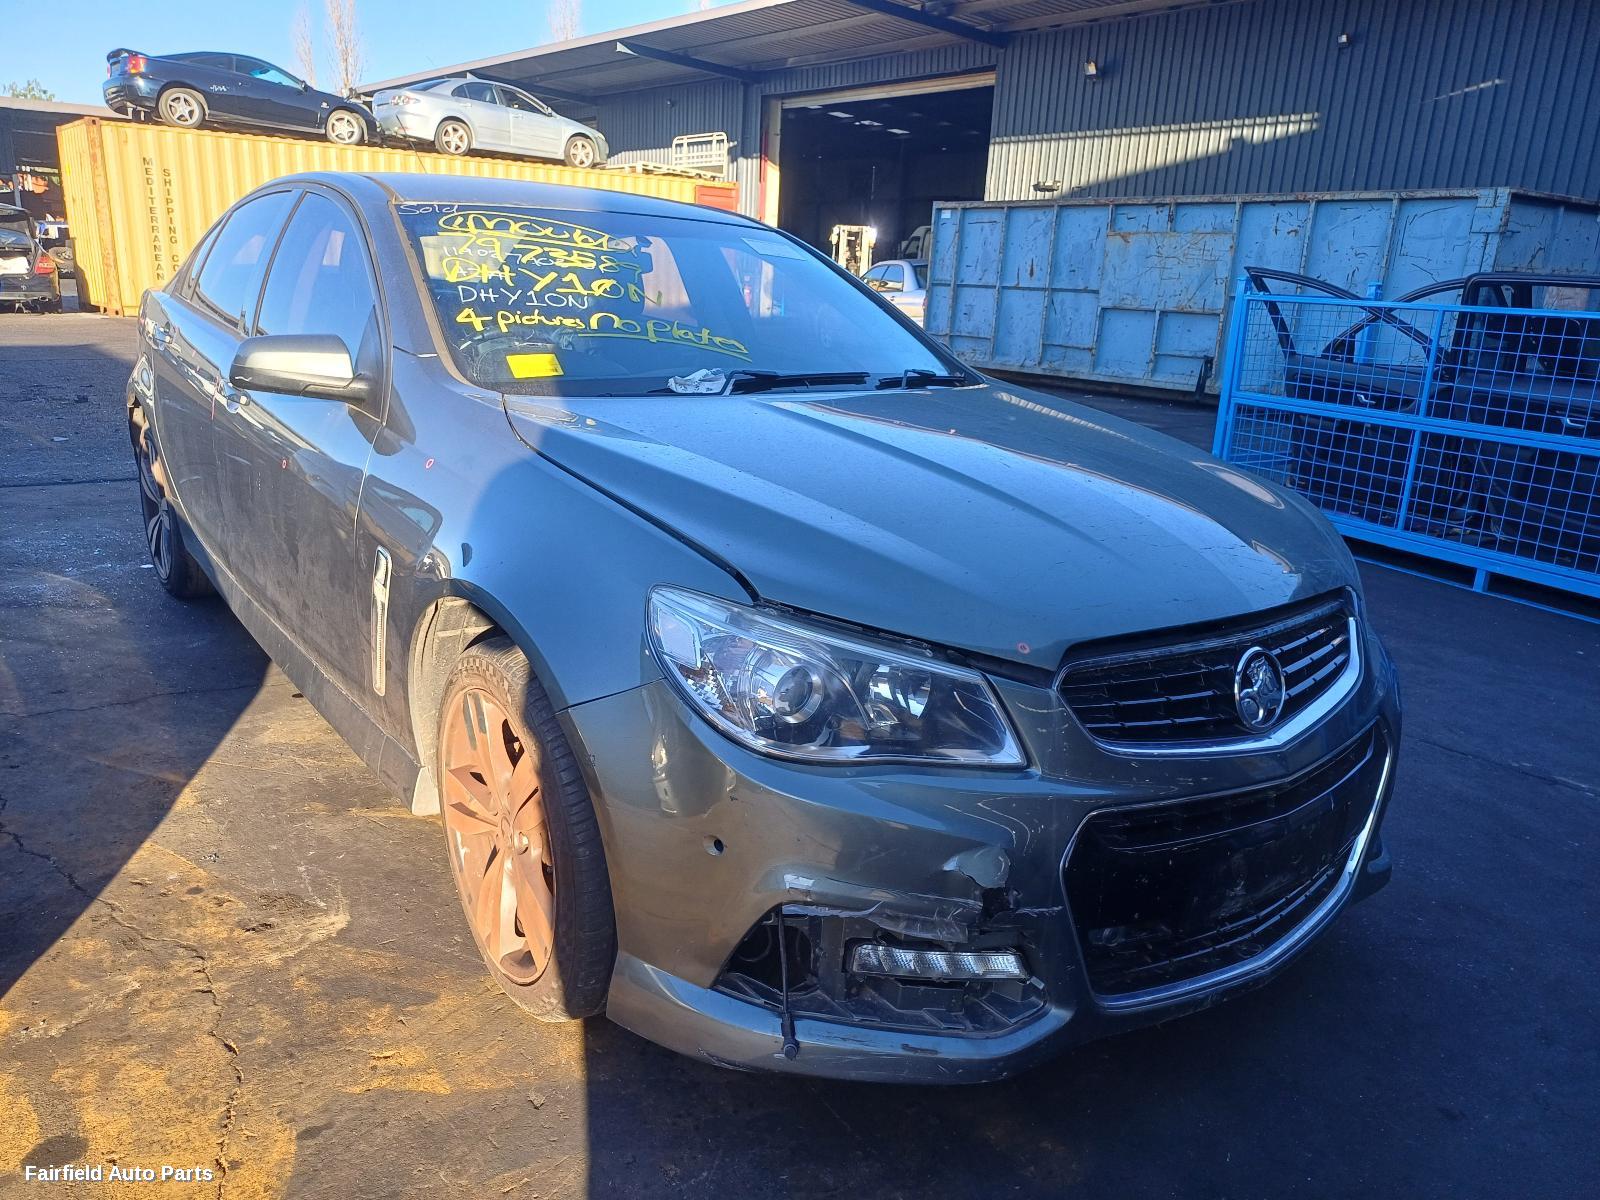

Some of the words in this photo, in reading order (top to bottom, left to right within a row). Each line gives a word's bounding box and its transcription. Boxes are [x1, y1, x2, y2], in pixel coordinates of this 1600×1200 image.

[142, 157, 165, 281] MEDITERRANEAN
[163, 168, 178, 245] SHIPPING
[398, 203, 460, 215] Sold
[455, 307, 493, 332] 4
